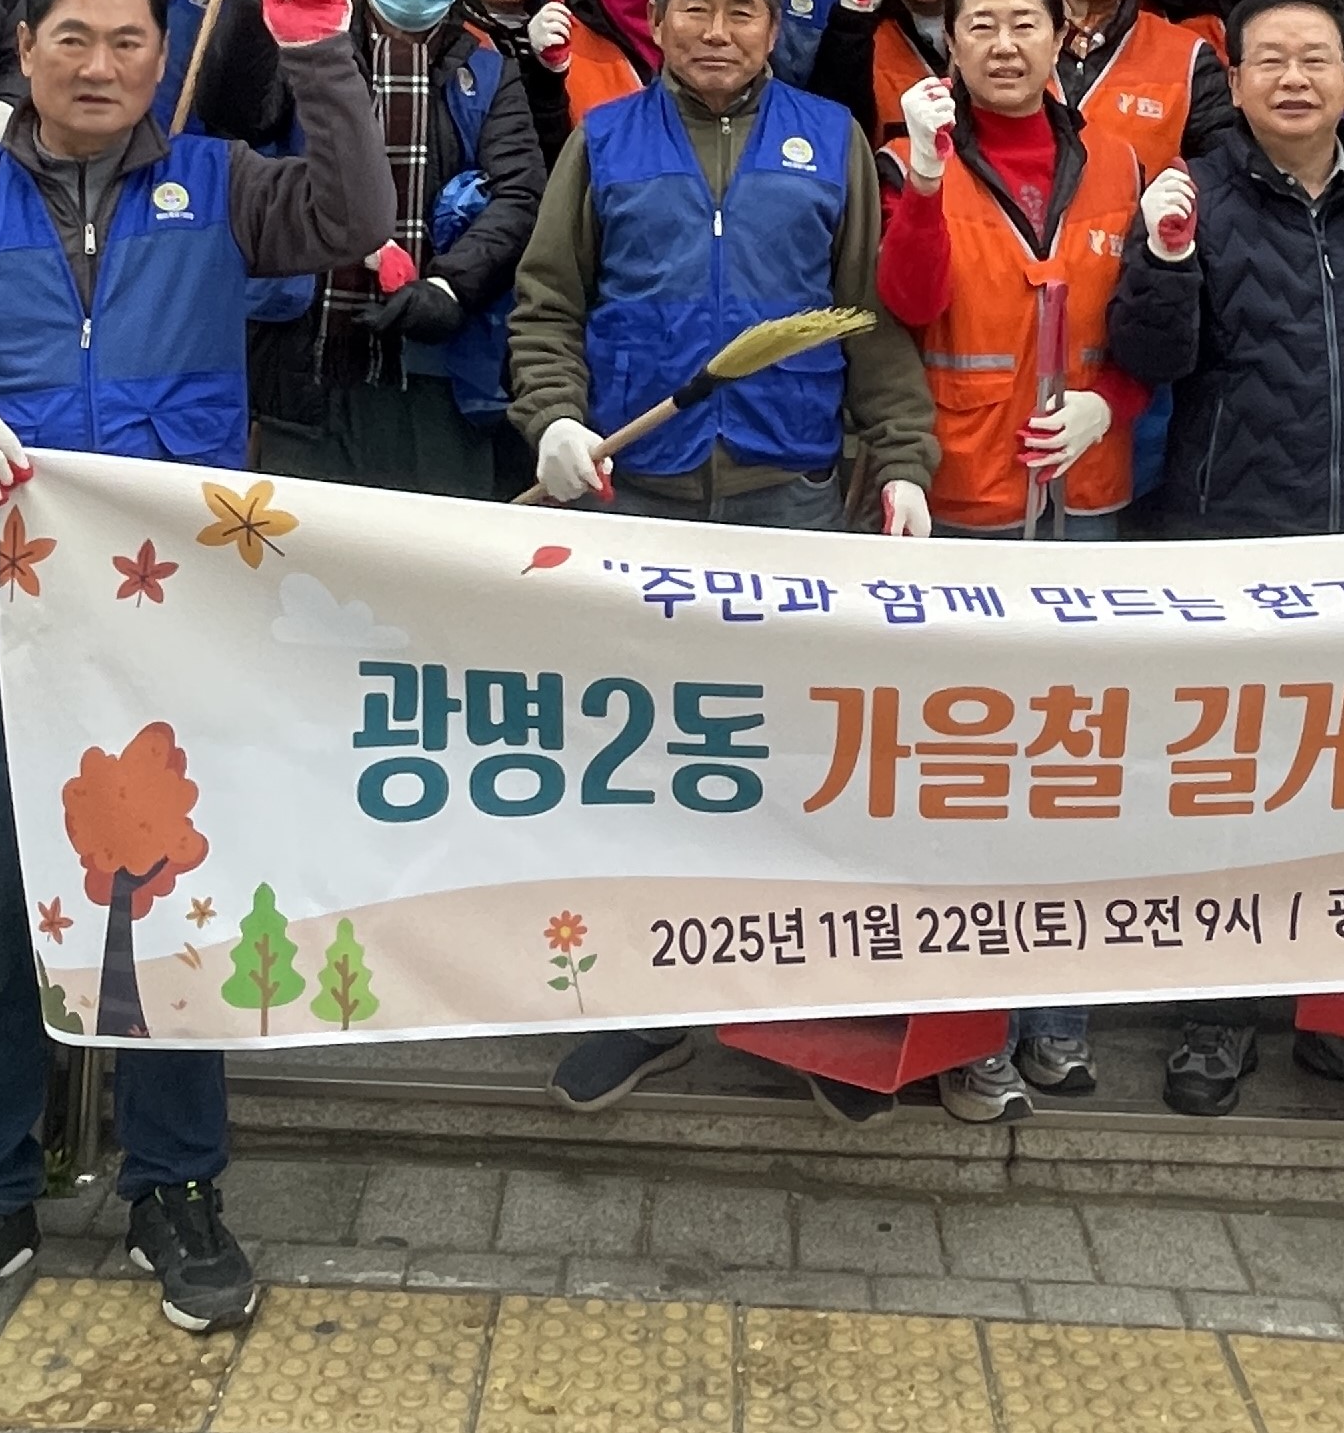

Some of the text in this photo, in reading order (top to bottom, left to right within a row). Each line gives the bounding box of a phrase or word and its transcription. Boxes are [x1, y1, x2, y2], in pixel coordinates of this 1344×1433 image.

[865, 578, 1005, 624] 함께
[1032, 584, 1226, 624] 만드는
[352, 659, 770, 823] 광명2동
[802, 685, 1130, 820] 가을철
[651, 906, 805, 967] 2025년
[821, 903, 902, 960] 11월
[917, 898, 1088, 957] 22일(토)
[1103, 893, 1183, 950] 오전
[1195, 892, 1263, 945] 9시
